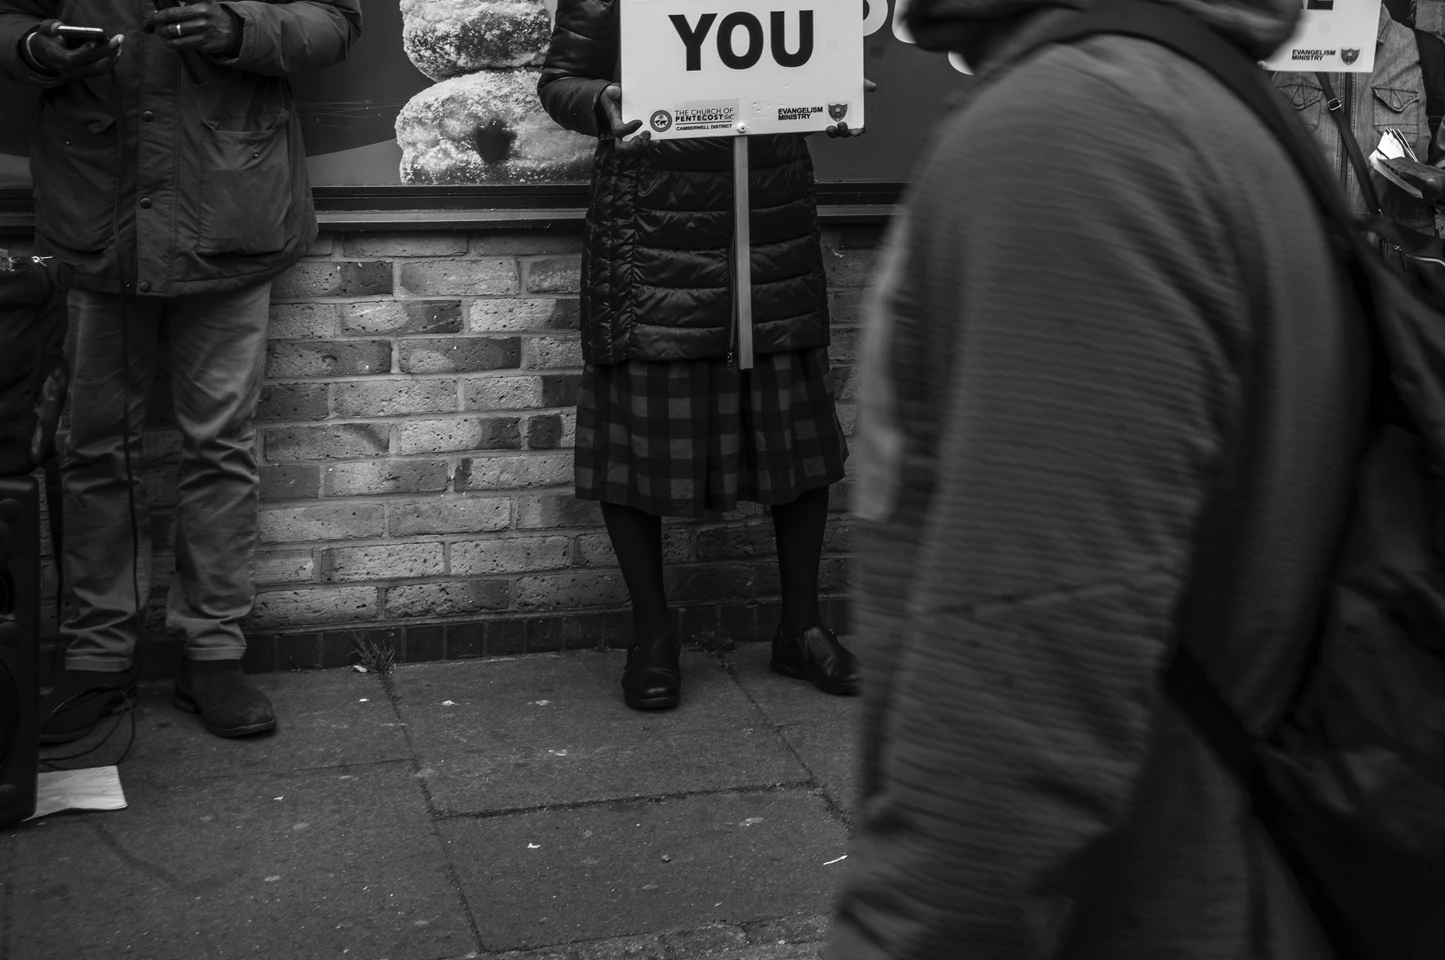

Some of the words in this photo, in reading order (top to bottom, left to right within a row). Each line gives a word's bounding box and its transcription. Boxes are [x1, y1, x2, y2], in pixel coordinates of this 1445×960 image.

[668, 9, 814, 72] YOU
[778, 106, 823, 115] EVANGELISM
[675, 114, 723, 122] PENTECOST
